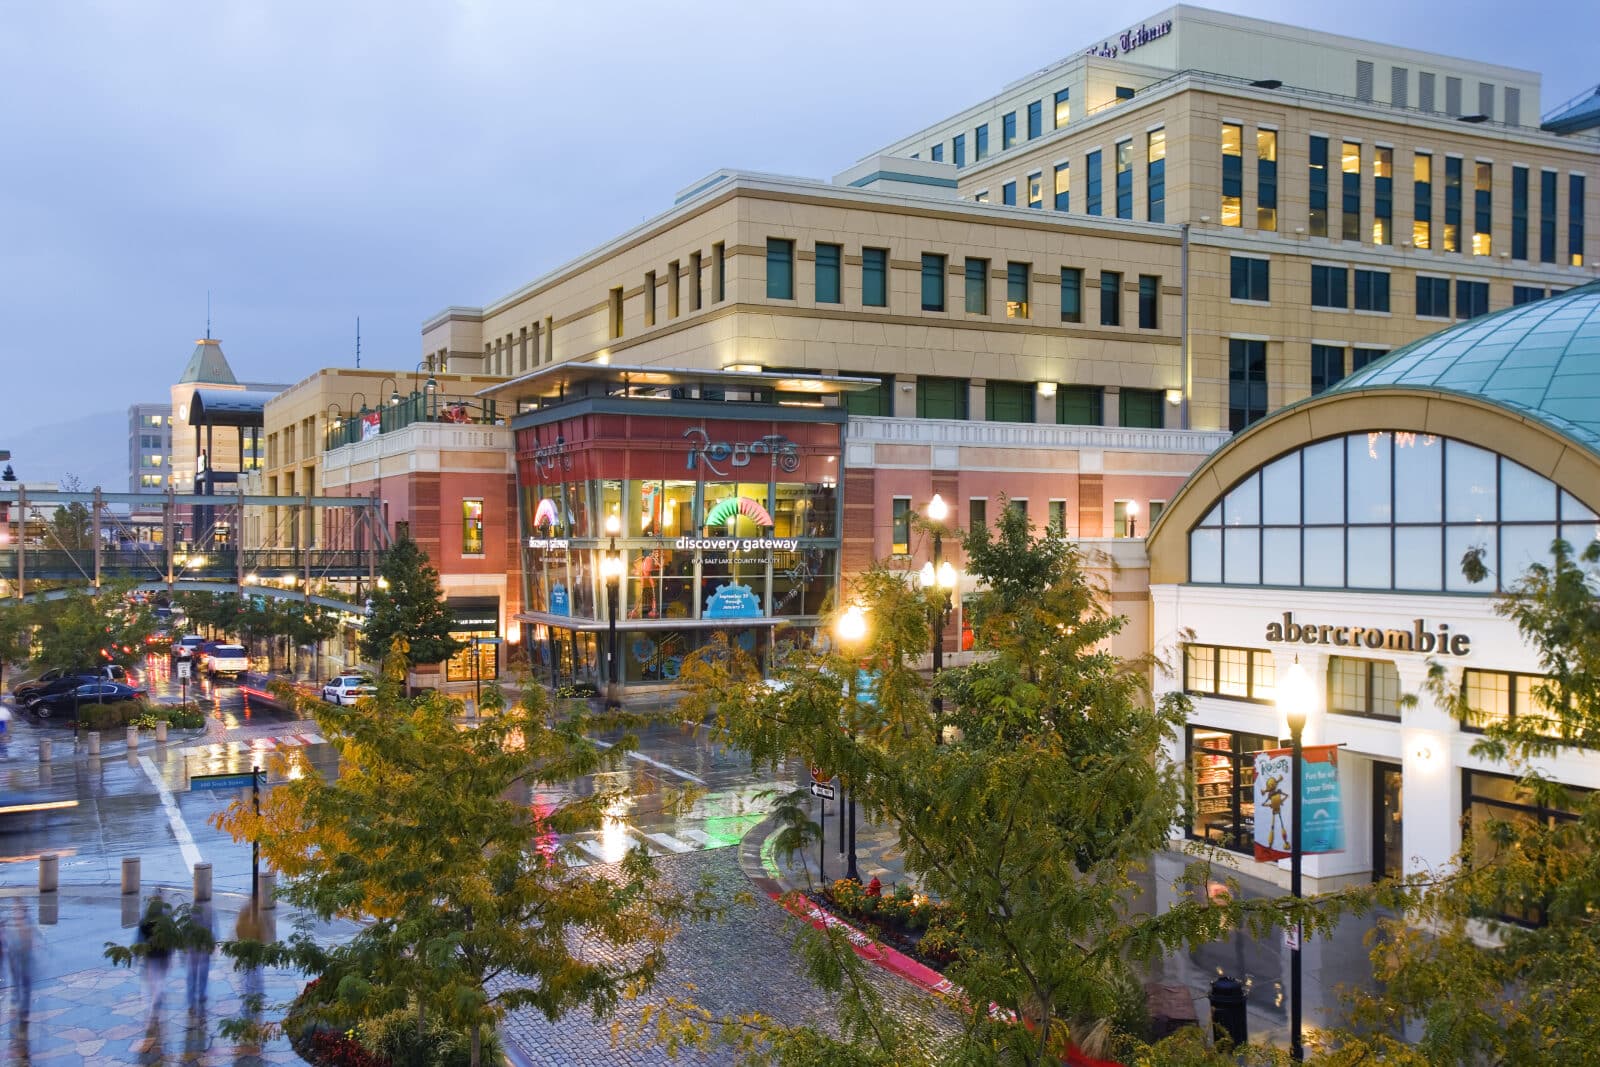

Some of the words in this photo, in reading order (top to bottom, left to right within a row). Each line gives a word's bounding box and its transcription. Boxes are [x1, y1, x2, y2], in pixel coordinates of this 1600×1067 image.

[1120, 20, 1172, 54] Tribune
[676, 536, 740, 552] discovery
[743, 539, 798, 552] gateway
[1265, 611, 1470, 656] abercrombie
